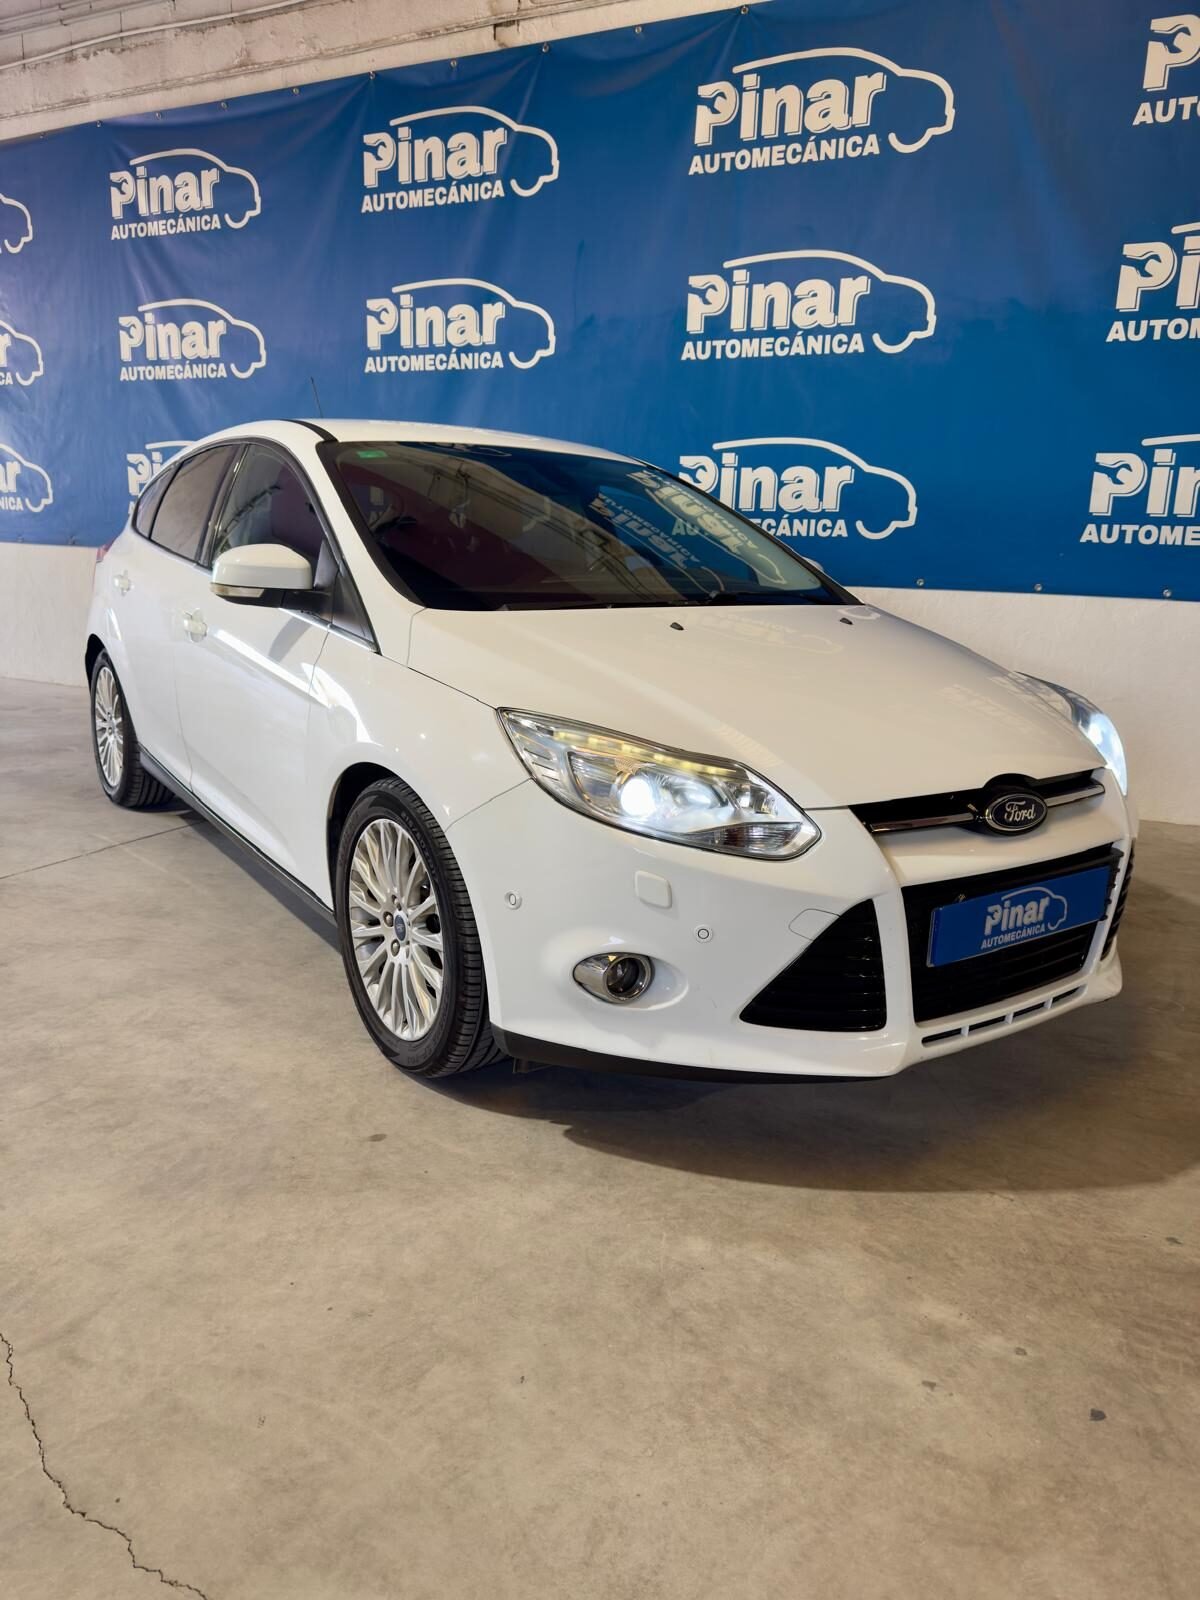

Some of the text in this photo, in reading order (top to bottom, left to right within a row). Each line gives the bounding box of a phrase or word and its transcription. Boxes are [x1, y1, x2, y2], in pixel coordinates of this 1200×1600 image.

[694, 72, 887, 147] Pinar
[1132, 95, 1200, 126] AUT
[363, 127, 507, 188] Pinar
[688, 134, 880, 175] AUTOMECÁNICA
[110, 166, 220, 219] Pinar
[361, 180, 505, 213] AUTOMECÁNICA
[111, 214, 221, 240] AUTOMECÁNICA
[686, 269, 871, 333] Pinar
[119, 312, 227, 362] Pinar
[366, 294, 505, 350] Pinar
[364, 348, 504, 373] AUTOMECÁNICA
[681, 331, 864, 360] AUTOMECÁNICA
[120, 361, 227, 381] AUTOMECÁNICA
[679, 453, 854, 512] Pinar
[1004, 800, 1036, 822] Ford
[980, 923, 1046, 950] AUTOMECÁNICA
[984, 896, 1050, 937] Pinar
